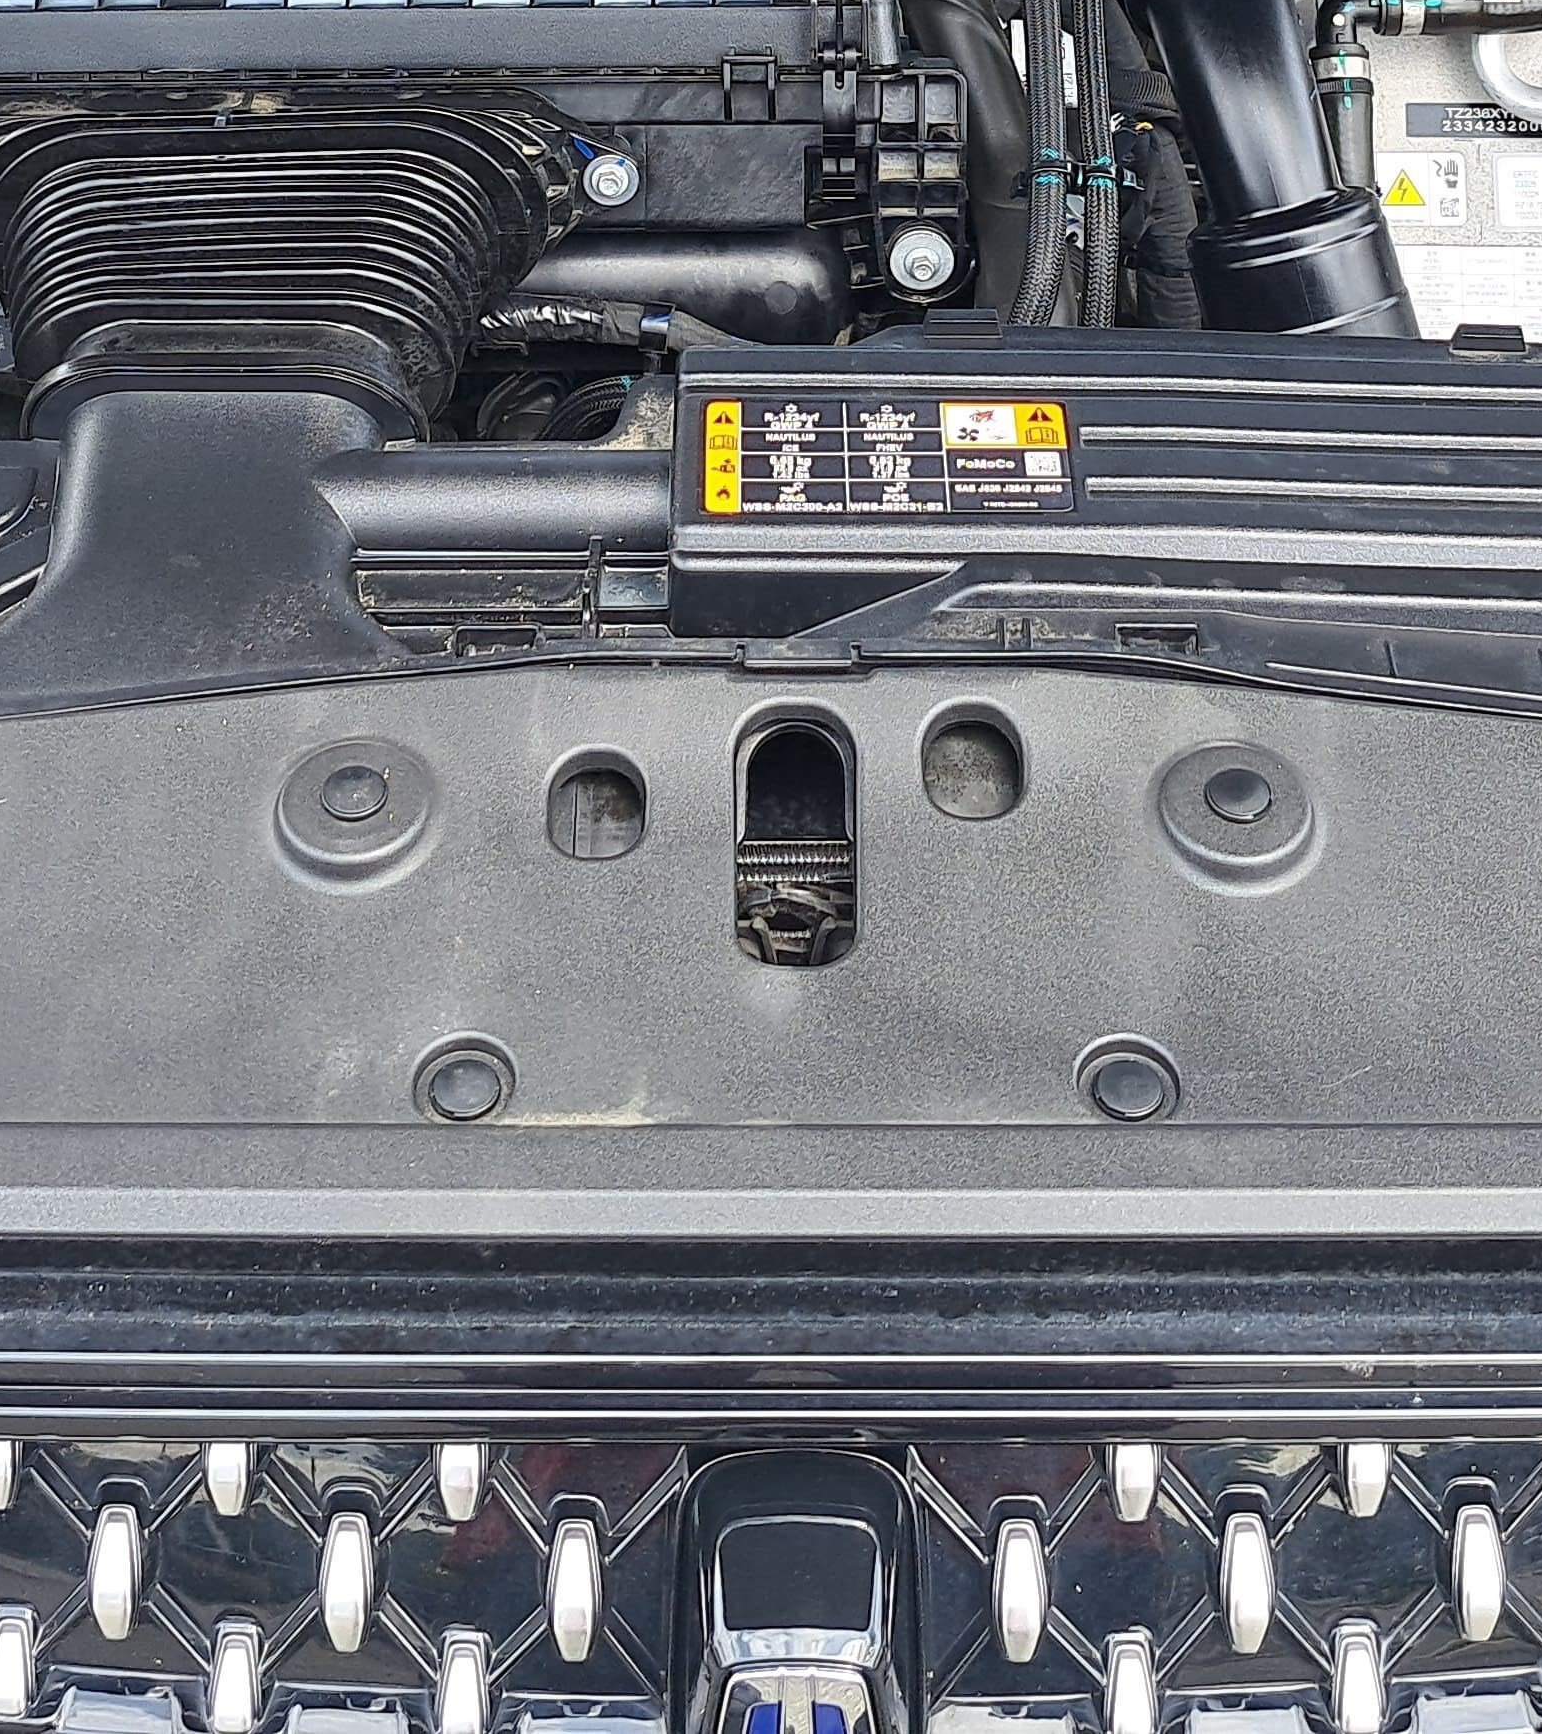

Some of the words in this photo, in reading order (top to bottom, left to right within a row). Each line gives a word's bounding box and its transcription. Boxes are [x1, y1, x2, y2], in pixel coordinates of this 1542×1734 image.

[1444, 107, 1516, 119] TZ236XY
[763, 412, 821, 423] R-1234yf
[859, 412, 916, 423] R-1234yf
[770, 421, 802, 429] GWP
[866, 421, 899, 429] GWP
[765, 432, 817, 442] NAUTILUS
[863, 432, 915, 442] NAUTILUS
[781, 444, 800, 452] ICE
[875, 444, 904, 452] FHEV
[797, 456, 812, 467] kg
[896, 456, 912, 467] kg
[956, 458, 1016, 470] FoMoCo
[954, 483, 977, 493] SAE
[778, 493, 807, 502] PAG
[882, 493, 910, 502] POE
